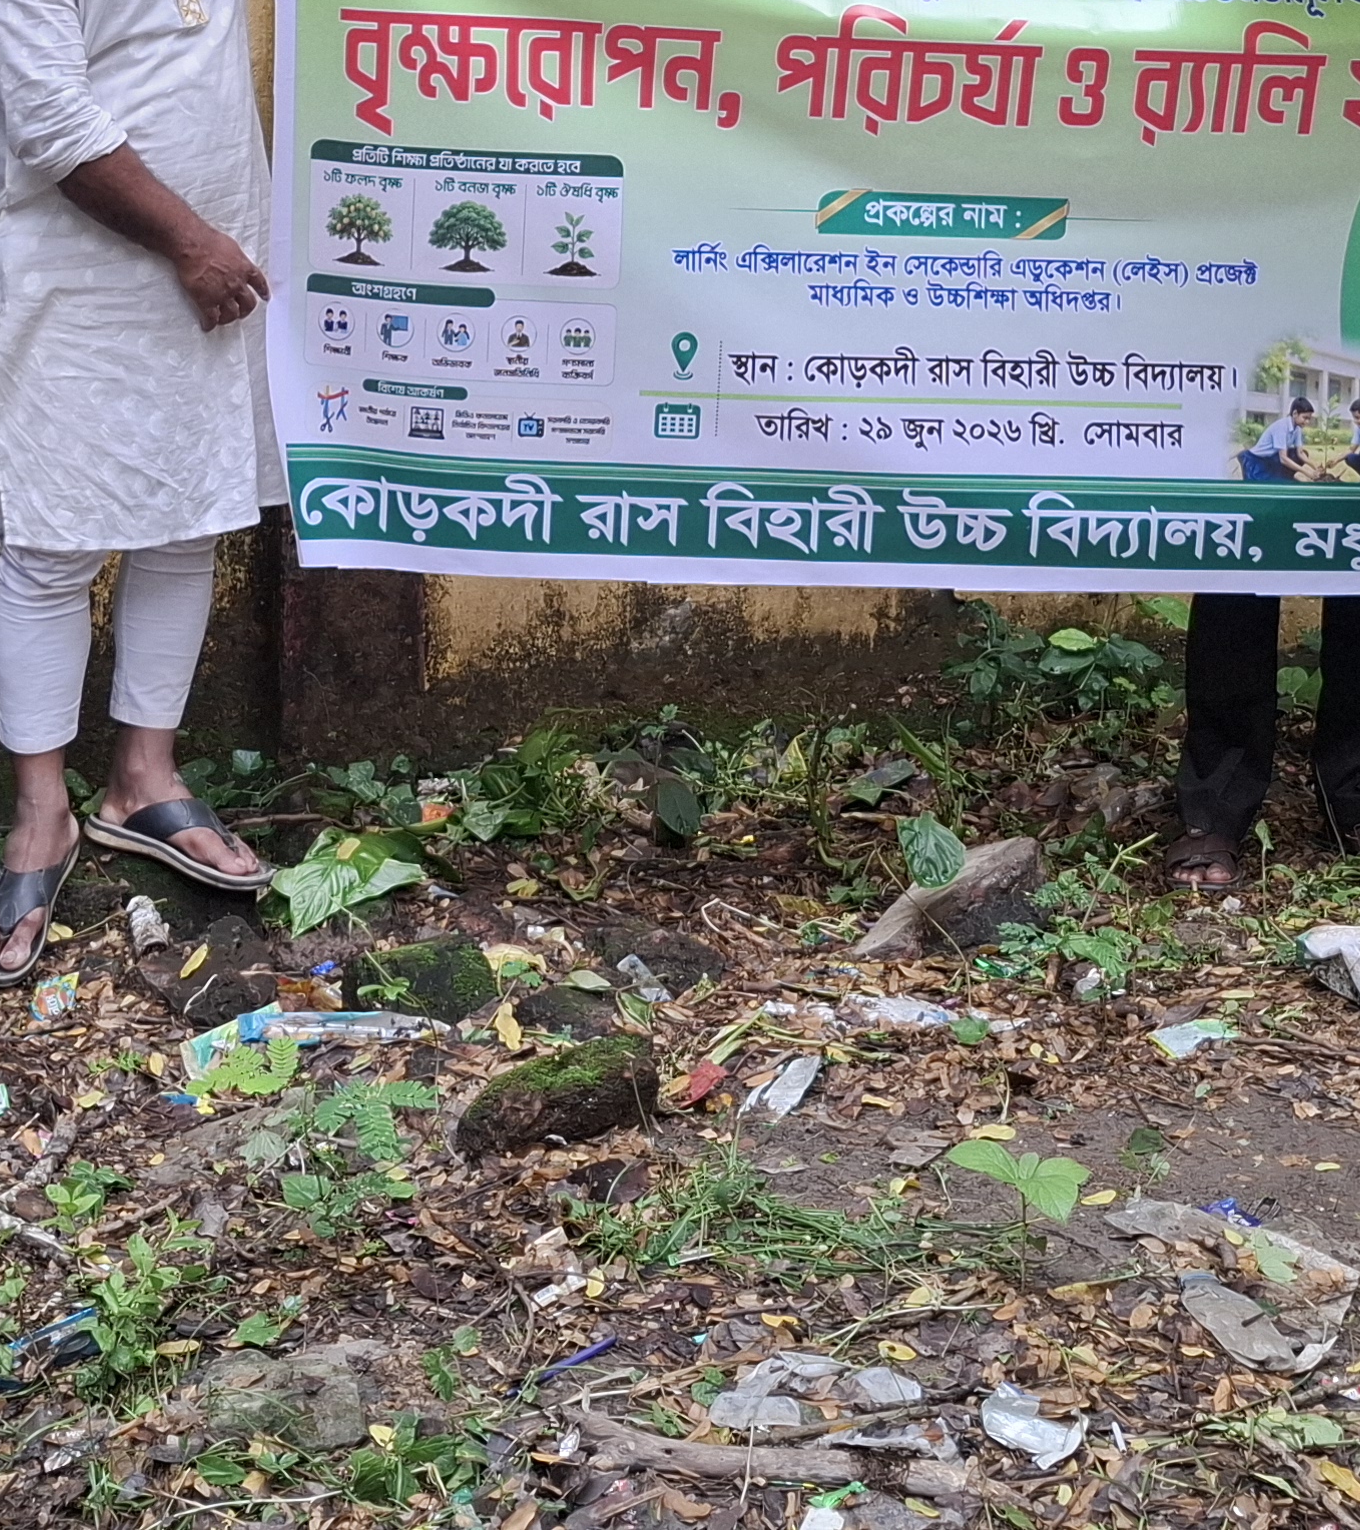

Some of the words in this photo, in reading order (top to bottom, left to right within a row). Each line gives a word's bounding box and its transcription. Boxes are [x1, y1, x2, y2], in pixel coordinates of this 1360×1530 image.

[339, 7, 742, 136] বৃক্ষরোপন,
[775, 3, 1044, 135] পরিচর্যা
[1058, 46, 1112, 127] ও
[351, 145, 390, 165] প্রতিটি
[391, 148, 427, 167] শিক্ষা
[429, 150, 496, 172] প্রতিষ্ঠানের
[498, 157, 513, 171] যা
[515, 158, 554, 173] করতে
[557, 160, 581, 173] হবে
[458, 180, 490, 195] বনজ
[864, 199, 955, 229] প্রকল্পের
[961, 202, 1008, 229] নাম
[672, 242, 728, 272] লার্নিং
[735, 244, 860, 275] এক্সিলারেশন
[864, 247, 898, 277] ইন
[1009, 258, 1107, 285] এডুকেশন
[1112, 254, 1190, 287] (লেইস)
[1195, 258, 1259, 286] প্রজেক্ট
[808, 278, 896, 308] মাধ্যমিক
[902, 289, 919, 305] ও
[926, 280, 1019, 312] উচ্চশিক্ষা
[728, 351, 779, 385] স্থান
[804, 346, 920, 389] কোড়কদী
[926, 354, 974, 386] রাস
[980, 349, 1060, 389] বিহারী
[1065, 350, 1117, 387] উচ্চ
[754, 407, 834, 443] তারিখ
[858, 416, 892, 444] ২৯
[900, 418, 945, 451] জুন
[952, 418, 1022, 445] ২০২৬
[1084, 419, 1184, 449] সোমবার
[300, 473, 564, 545] কোড়কদী
[575, 489, 689, 548] রাস
[700, 481, 885, 555] বিহারী
[898, 488, 1011, 553] উচ্চ
[1022, 490, 1264, 565] বিদ্যালয়,
